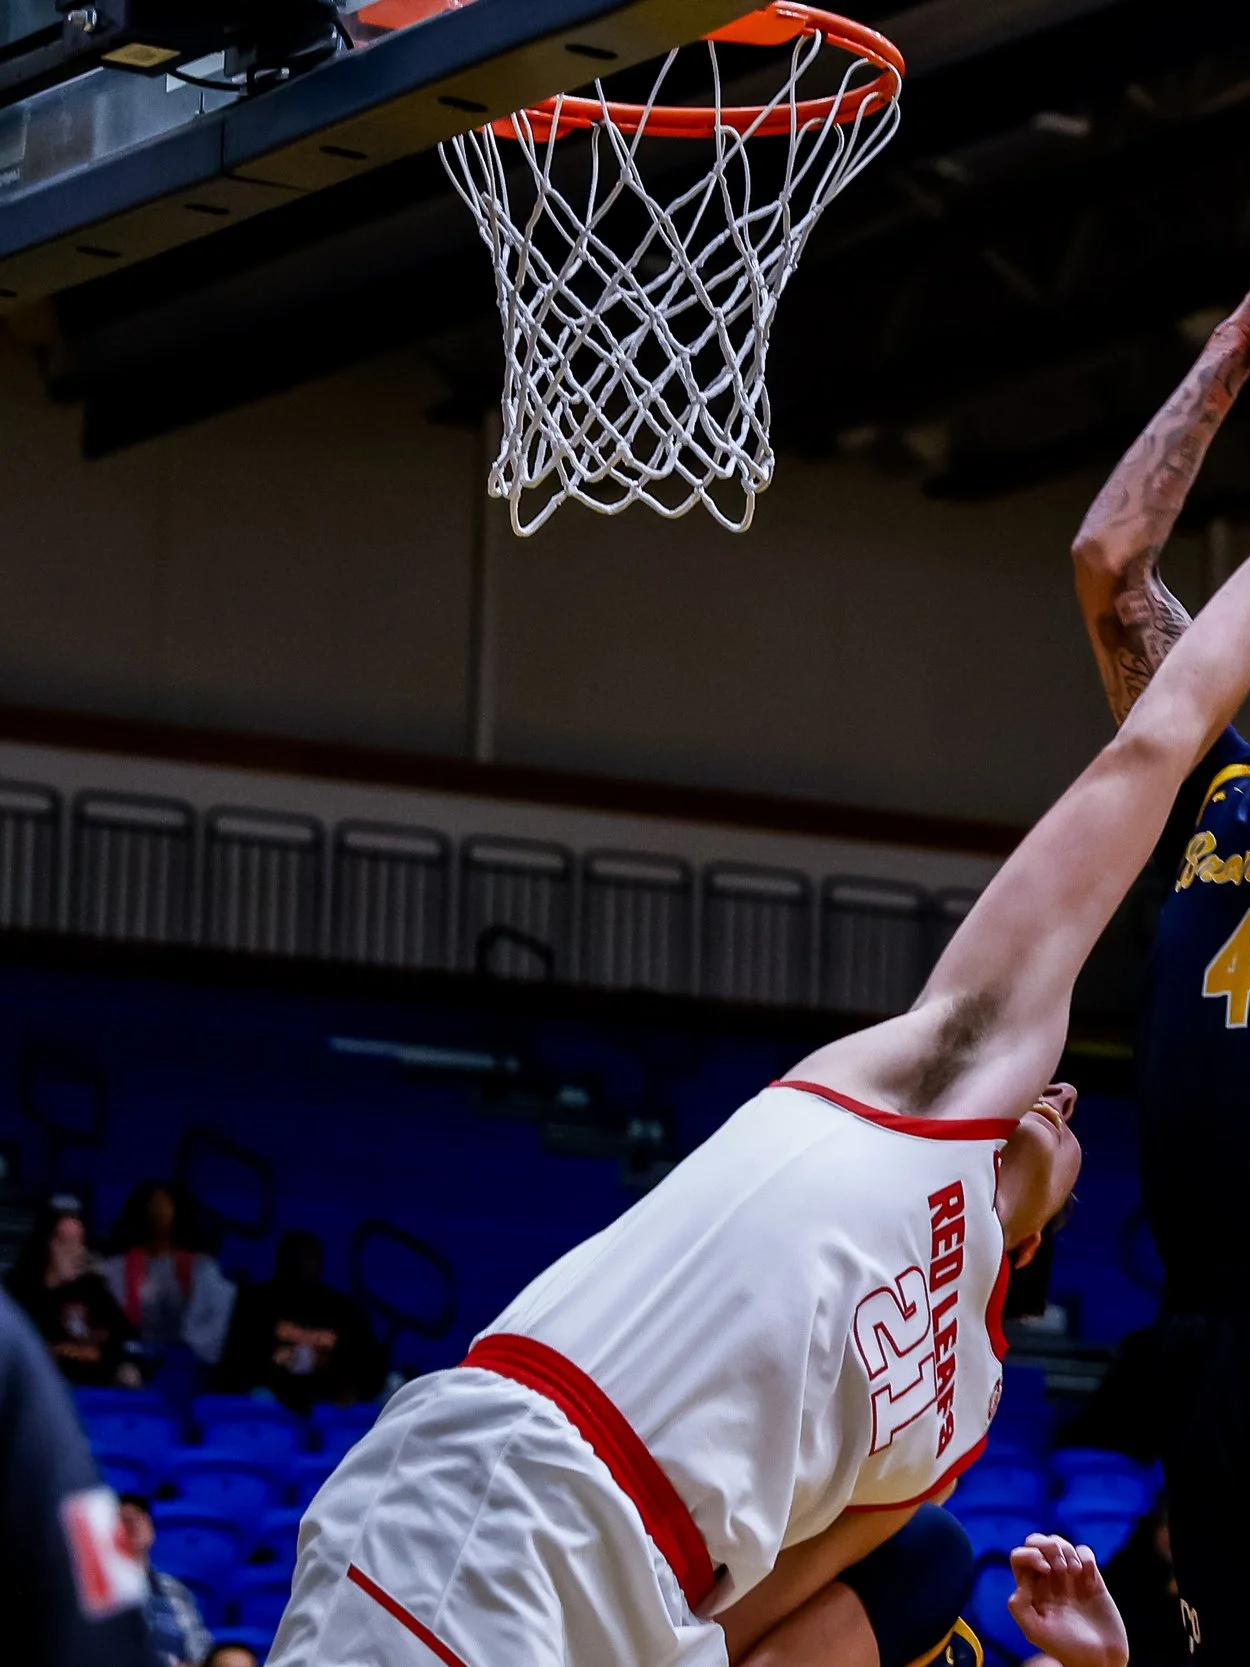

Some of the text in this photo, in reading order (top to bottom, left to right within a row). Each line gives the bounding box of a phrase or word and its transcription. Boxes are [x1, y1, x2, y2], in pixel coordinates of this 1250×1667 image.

[853, 1264, 939, 1457] 21
[927, 1180, 966, 1459] RED LEAFS
